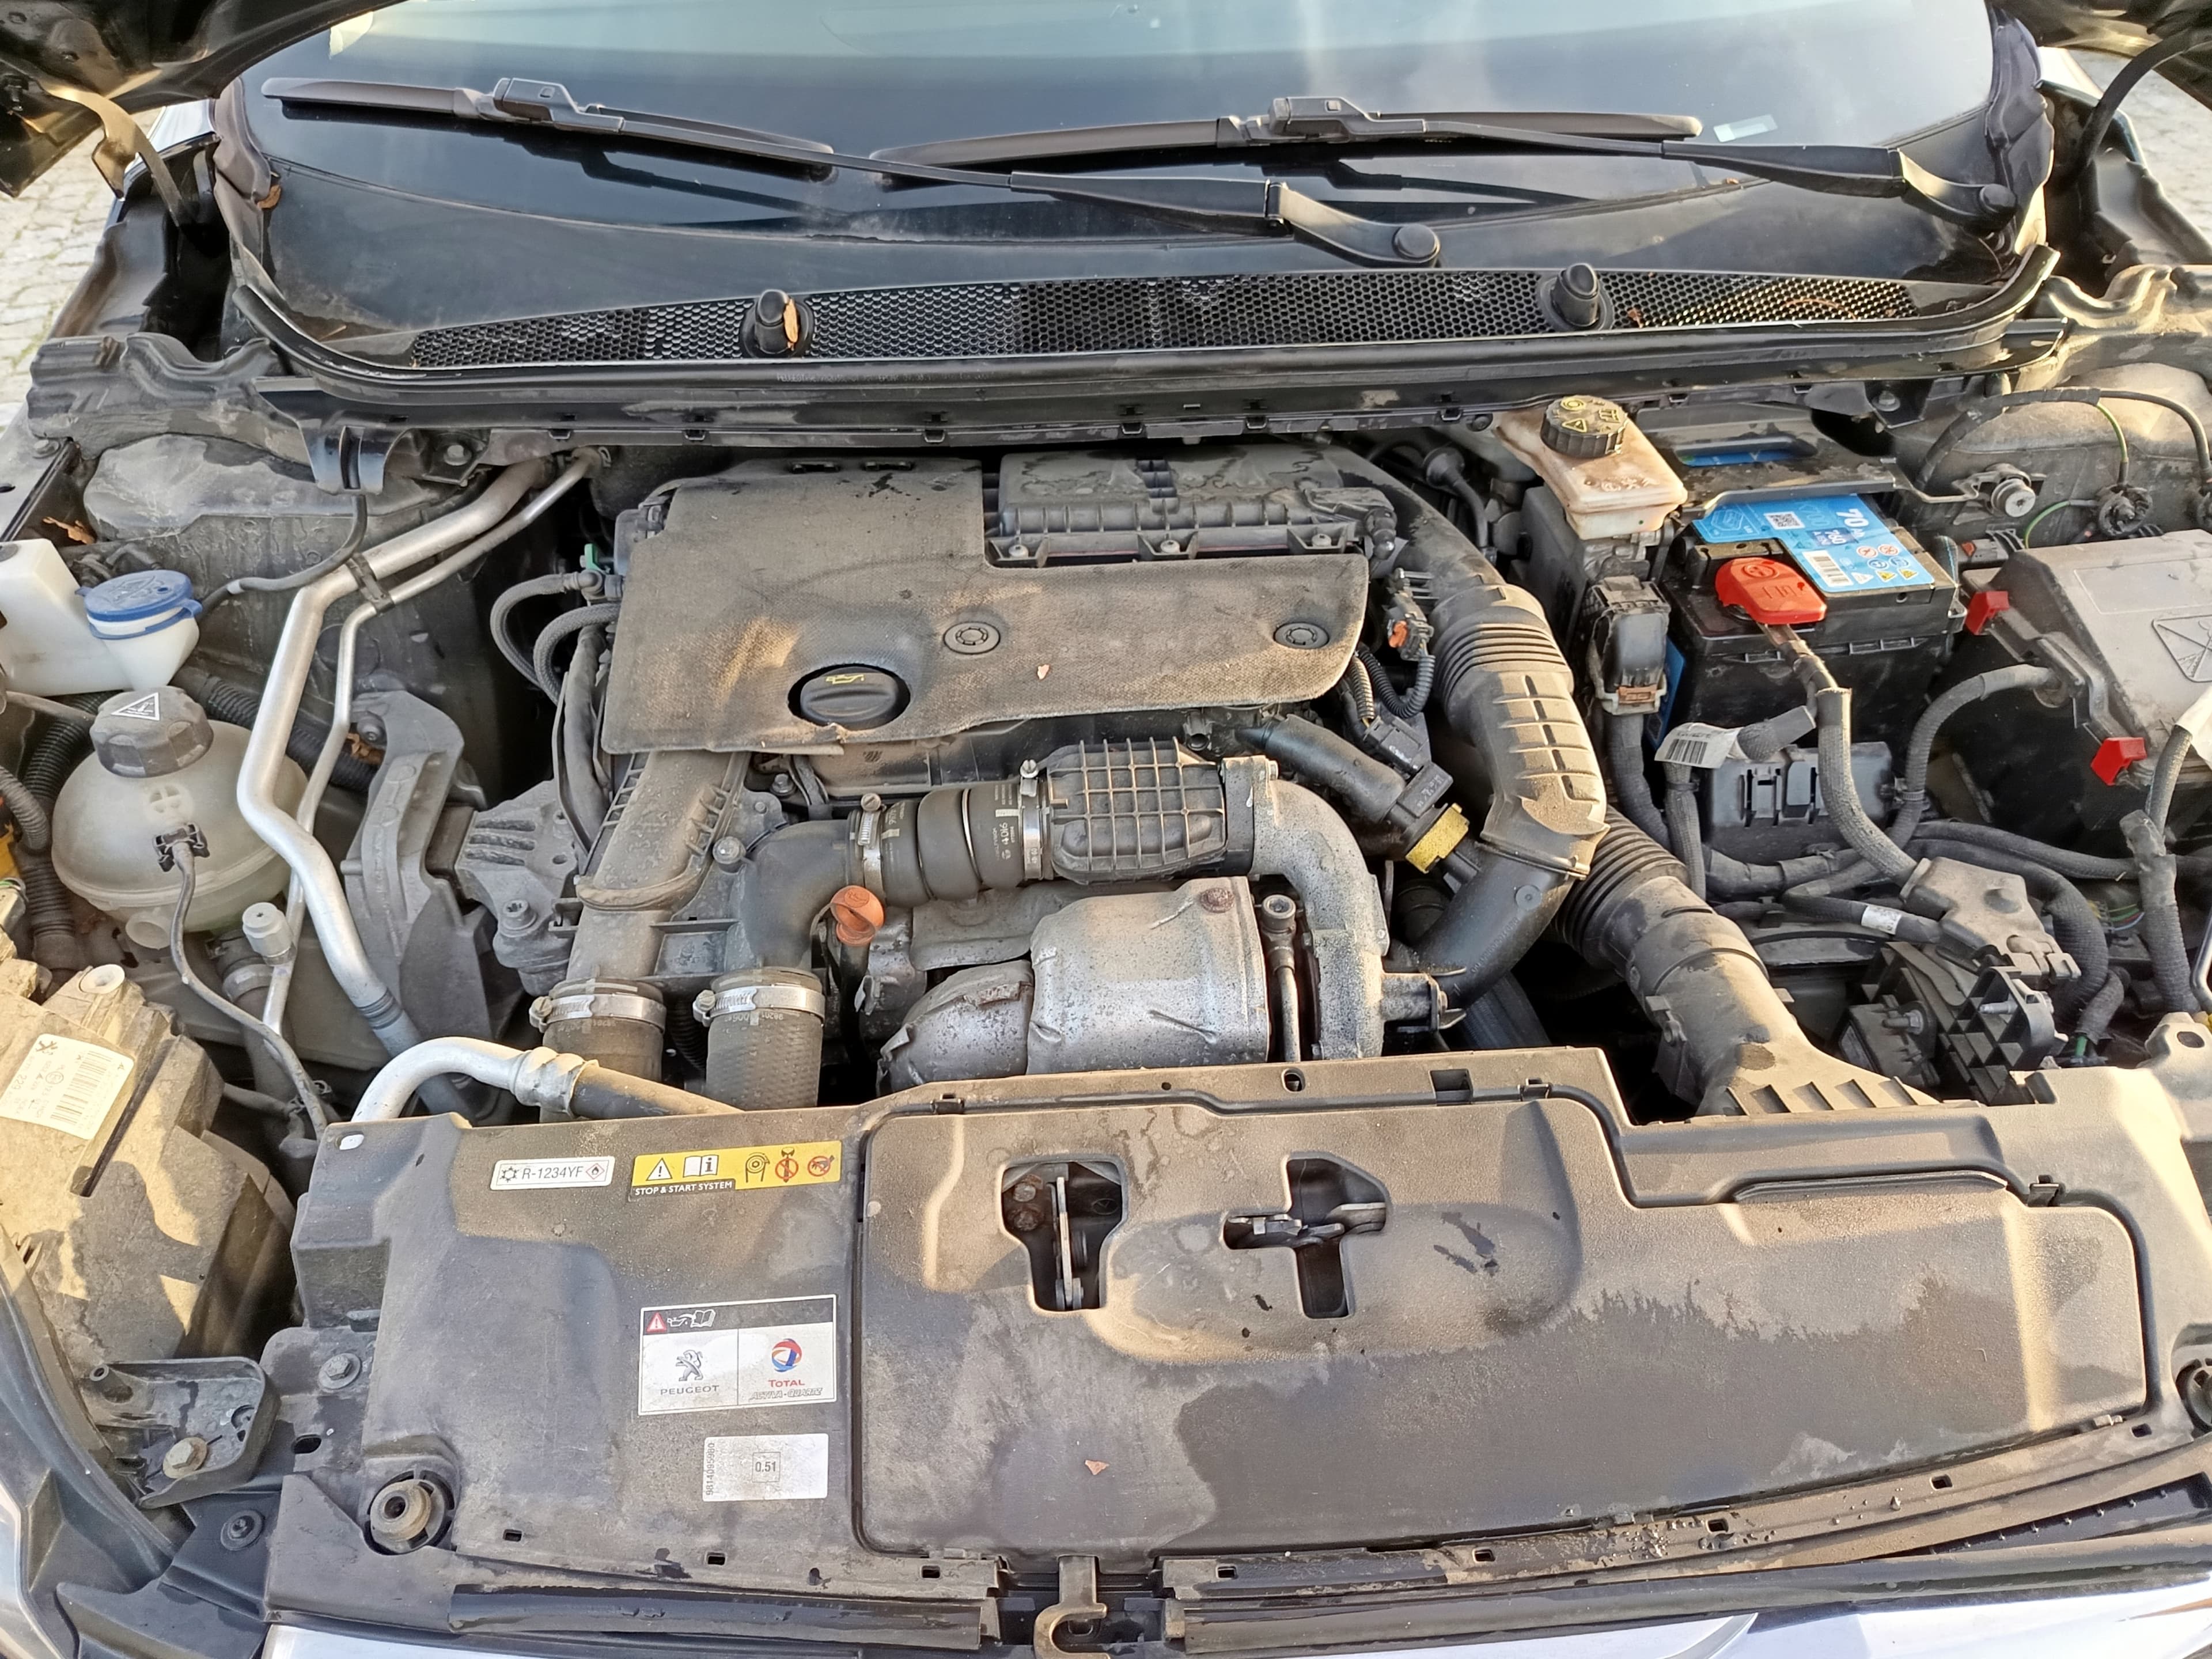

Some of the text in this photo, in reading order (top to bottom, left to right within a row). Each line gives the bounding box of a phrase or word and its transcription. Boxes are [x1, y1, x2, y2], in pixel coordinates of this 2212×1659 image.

[1835, 508, 1869, 528] 70
[1824, 529, 1846, 545] 760
[522, 1166, 584, 1180] R-1234YF
[635, 1186, 659, 1196] STOP
[668, 1184, 697, 1193] START
[698, 1181, 733, 1191] SYSTEM
[660, 1385, 720, 1396] PEUGEOT
[768, 1379, 805, 1388] TOTAL
